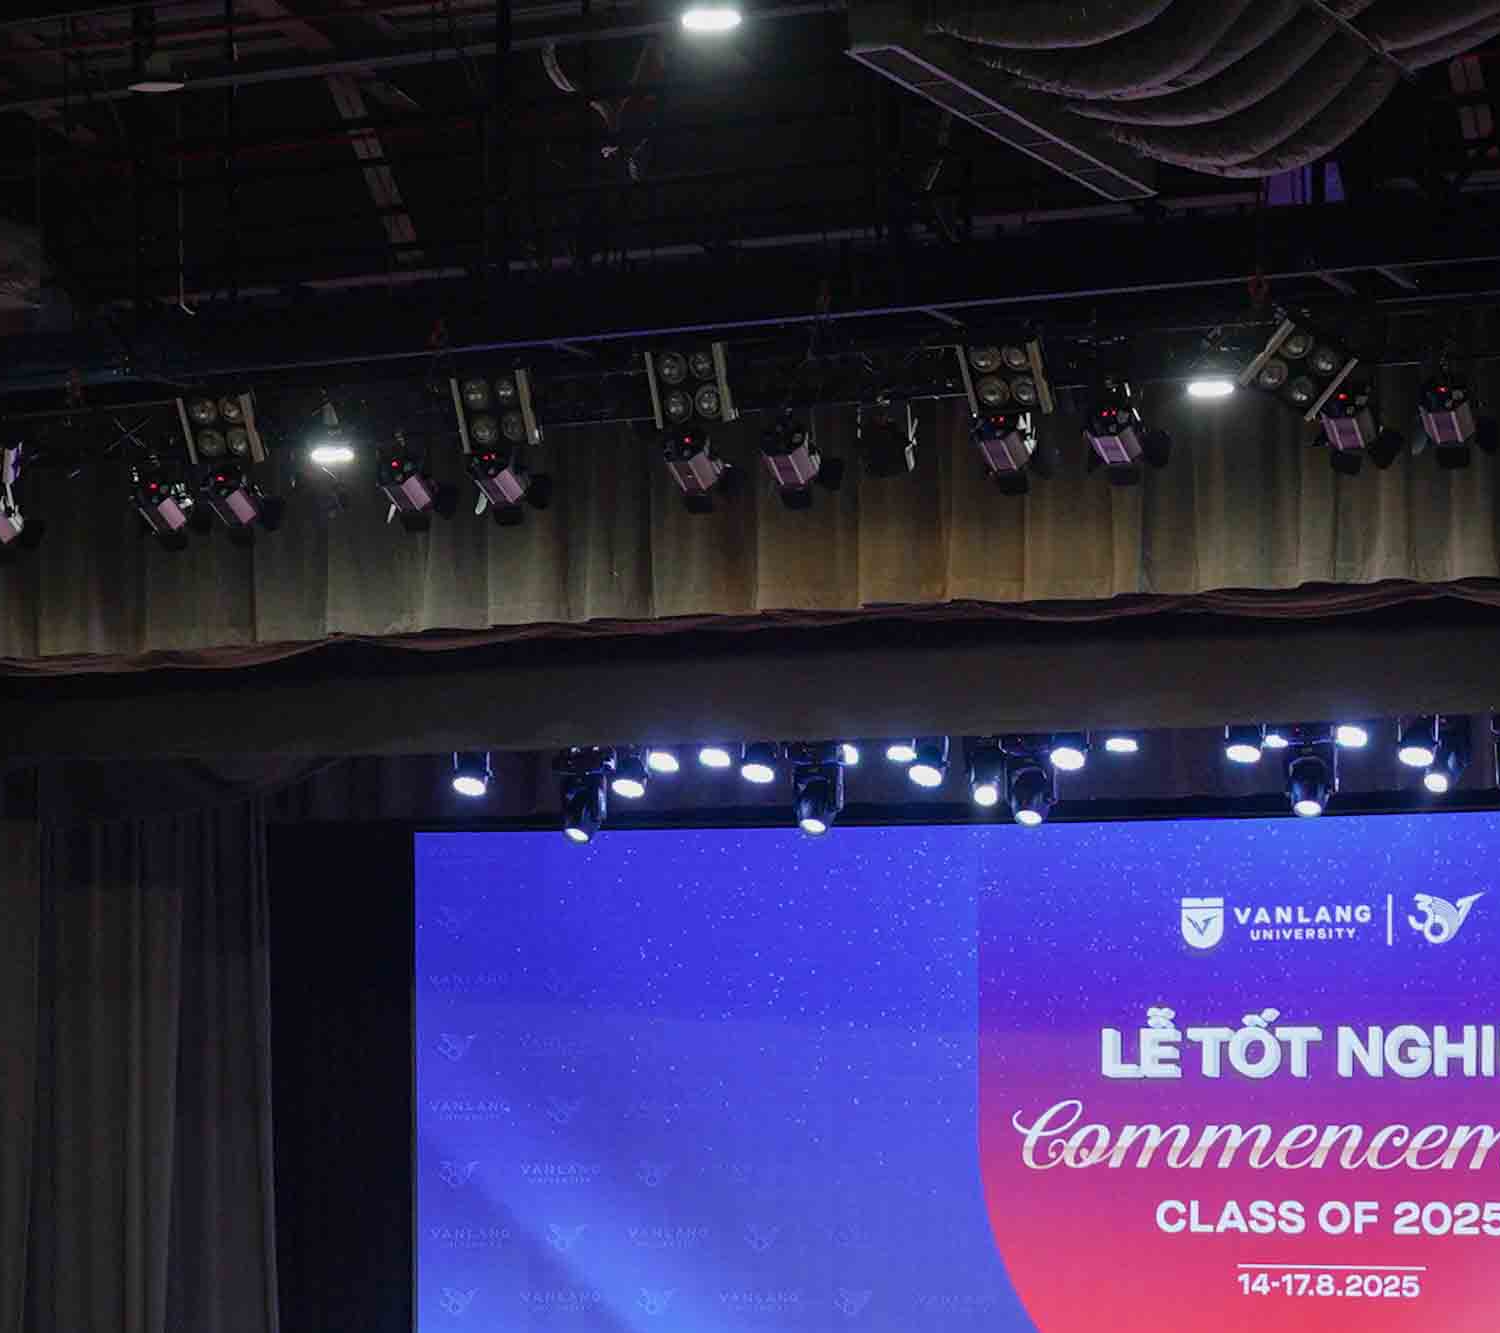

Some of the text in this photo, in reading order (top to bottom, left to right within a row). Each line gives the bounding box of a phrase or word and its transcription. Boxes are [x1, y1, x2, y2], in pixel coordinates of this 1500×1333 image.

[1233, 906, 1372, 924] VANLANG
[1250, 928, 1356, 941] UNIVERSITY
[1102, 1008, 1181, 1078] LỄ
[1186, 1008, 1322, 1078] TỐT
[1155, 1200, 1305, 1233] CLASS
[1319, 1201, 1379, 1234] OF
[1238, 1274, 1420, 1298] 14-17.8.2025
